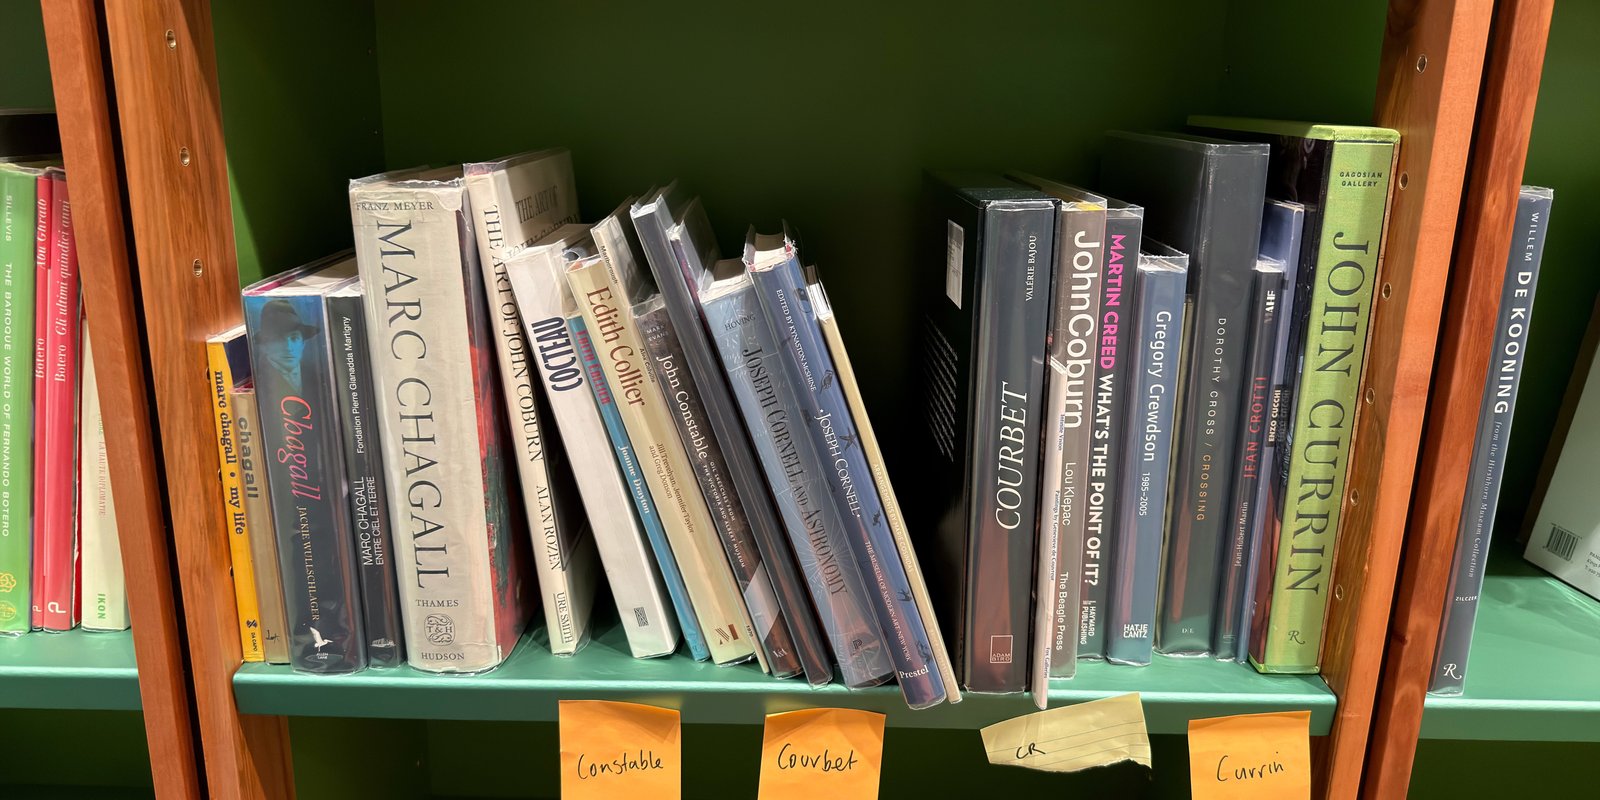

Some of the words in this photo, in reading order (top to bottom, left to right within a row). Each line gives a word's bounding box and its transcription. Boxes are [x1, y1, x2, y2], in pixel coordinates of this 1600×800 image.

[1339, 171, 1383, 179] GAGOSIAN
[5, 195, 13, 242] SILLEVIS
[37, 198, 47, 243] Ghraib
[62, 200, 71, 228] anni
[356, 202, 390, 211] FRANZ
[394, 201, 434, 211] MEYER
[514, 194, 535, 224] THE
[533, 189, 550, 217] ART
[484, 204, 505, 250] THE
[1525, 211, 1540, 262] WILLEM
[37, 244, 47, 270] Abu
[58, 230, 72, 280] quindici
[1027, 235, 1037, 265] BAJOU
[4, 263, 13, 287] THE
[492, 254, 512, 298] ART
[1025, 266, 1035, 302] VALÉRIE
[1105, 234, 1127, 307] MARTIN
[1514, 271, 1533, 298] DE
[56, 280, 68, 317] ultimi
[376, 220, 427, 360] MARC
[776, 288, 790, 316] EDITED
[1315, 231, 1369, 373] JOHN
[4, 290, 13, 354] BAROQUE
[56, 317, 67, 336] Gli
[500, 302, 519, 327] OF
[724, 314, 756, 331] HOVING
[786, 315, 793, 326] BY
[1064, 230, 1100, 429] JohnCoburn
[343, 316, 354, 353] Martigny
[587, 286, 625, 343] Edith
[610, 345, 645, 406] Collier
[789, 325, 808, 362] KYNASTON
[1100, 311, 1119, 369] CREED
[1148, 310, 1172, 378] Gregory
[1212, 317, 1227, 383] DOROTHY
[35, 337, 45, 378] Botero
[55, 344, 66, 383] Botero
[346, 353, 358, 391] Gianadda
[503, 329, 528, 380] JOHN
[531, 316, 584, 392] COCTEAU
[1494, 307, 1526, 414] KOONING
[3, 356, 12, 400] WORLD
[214, 371, 227, 408] marc
[3, 403, 11, 421] OF
[352, 391, 362, 415] Pierre
[656, 354, 681, 389] John
[675, 390, 708, 460] Constable
[1094, 373, 1114, 440] WHAT'S
[1206, 390, 1219, 436] CROSS
[1250, 376, 1267, 433] CROTTI
[1271, 389, 1281, 419] CUCCHI
[219, 412, 237, 465] chagall
[352, 416, 365, 454] Fondation
[516, 384, 545, 463] COBURN
[1143, 384, 1165, 461] Crewdson
[1268, 420, 1277, 442] ENZO
[1494, 421, 1503, 443] from
[3, 424, 11, 488] FERNANDO
[238, 416, 259, 499] chagall
[277, 395, 321, 501] Chagall
[814, 412, 841, 457] JOSEPH
[834, 458, 859, 516] CORNELL
[996, 381, 1027, 530] COURBET
[1091, 443, 1108, 477] THE
[1244, 441, 1257, 479] JEAN
[1490, 443, 1498, 458] the
[366, 476, 377, 504] TERRE
[396, 377, 450, 589] CHAGALL
[618, 445, 636, 477] Joanne
[633, 478, 650, 514] Drayton
[649, 445, 657, 458] and
[654, 458, 663, 475] Greg
[661, 474, 673, 499] Donson
[656, 443, 665, 454] Jill
[661, 453, 676, 487] Trevelyan,
[673, 488, 688, 513] Jennifer
[684, 513, 695, 533] Taylor
[743, 347, 778, 409] JOSEPH
[766, 408, 804, 483] CORNELL
[791, 486, 809, 508] AND
[801, 508, 848, 596] ASTRONOMY
[873, 462, 895, 514] ARRANGEMENTS
[1065, 462, 1076, 484] Lou
[1197, 454, 1211, 521] CROSSING
[1482, 459, 1496, 500] Hirshhorn
[229, 486, 241, 509] my
[353, 476, 370, 530] CHAGALL
[537, 485, 552, 524] ALAN
[709, 461, 717, 472] OIL
[714, 472, 729, 504] SKETCHES
[725, 505, 736, 522] FROM
[1062, 485, 1076, 526] Klepac
[1088, 482, 1105, 534] POINT
[1285, 399, 1346, 596] CURRIN
[1, 491, 10, 537] BOTERO
[233, 512, 246, 535] life
[296, 505, 311, 541] JACKIE
[369, 505, 379, 516] ET
[371, 517, 381, 537] CIEL
[702, 464, 710, 476] THE
[707, 476, 721, 506] VICTORIA
[718, 506, 727, 519] AND
[723, 519, 736, 542] ALBERT
[733, 543, 746, 568] MUSEUM
[890, 513, 897, 521] BY
[1239, 501, 1248, 525] Martin
[1476, 502, 1487, 536] Museum
[360, 532, 374, 566] MARC
[544, 525, 561, 571] ROZEN
[865, 540, 873, 555] THE
[892, 521, 905, 541] MARIE
[1086, 536, 1101, 560] OF
[1234, 525, 1245, 567] Jean-Hubert
[373, 537, 384, 566] ENTRE
[869, 554, 883, 584] MUSEUM
[899, 540, 914, 573] COSINDAS
[1468, 537, 1482, 578] Collection
[302, 541, 320, 621] WULLSCHLAGER
[879, 581, 886, 591] OF
[1059, 571, 1068, 590] The
[1084, 563, 1100, 586] IT?
[97, 593, 105, 620] IKON
[416, 599, 459, 608] THAMES
[555, 592, 566, 613] URE
[882, 590, 896, 616] MODERN
[1056, 591, 1067, 624] Beagle
[559, 613, 573, 644] SMITH
[897, 630, 905, 644] NEW
[1056, 625, 1065, 651] Press
[1080, 606, 1089, 645] PUBLISHING
[1088, 606, 1096, 637] HAYWARD
[1123, 624, 1148, 632] HATJE
[1288, 630, 1306, 644] R
[421, 652, 465, 661] HUDSON
[901, 645, 911, 661] YORK
[1443, 663, 1463, 680] R
[899, 665, 929, 679] Prestel
[577, 750, 664, 780] Constable
[777, 743, 858, 771] Courbet
[1015, 742, 1046, 760] CR
[1216, 751, 1284, 782] Currin
